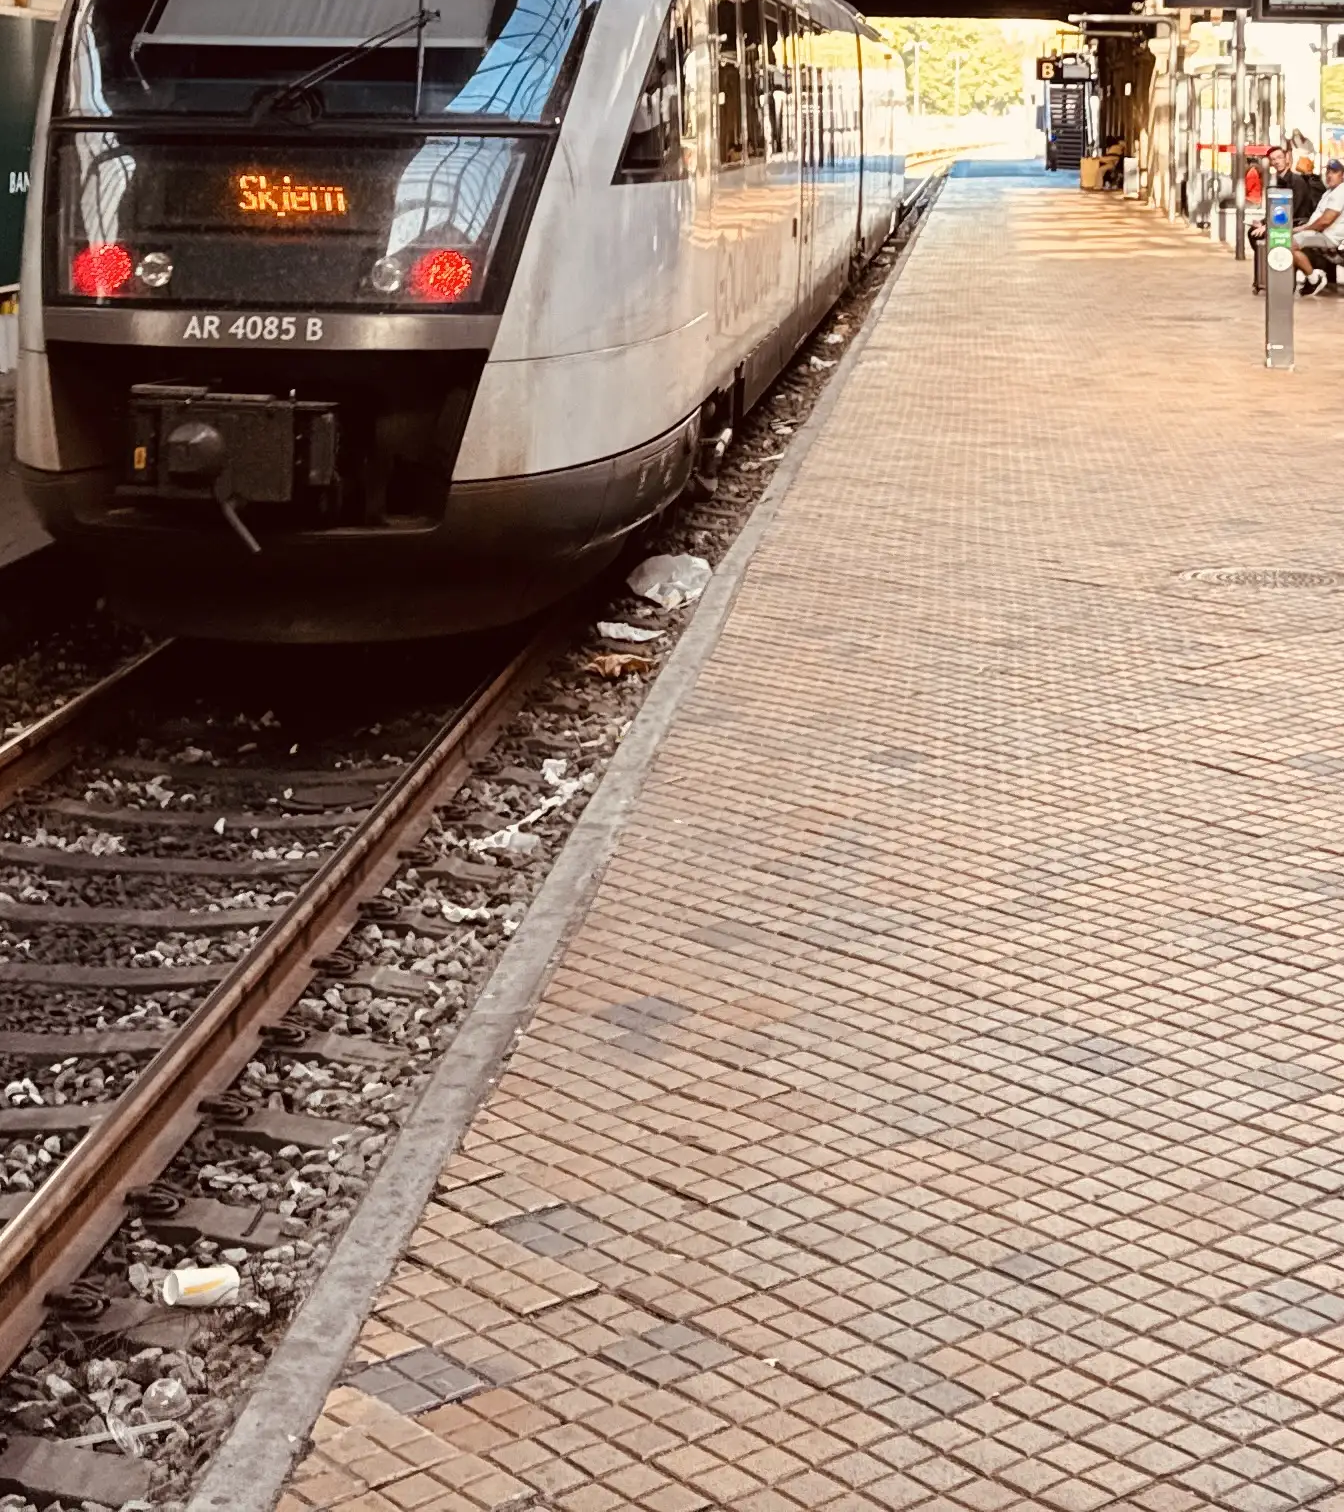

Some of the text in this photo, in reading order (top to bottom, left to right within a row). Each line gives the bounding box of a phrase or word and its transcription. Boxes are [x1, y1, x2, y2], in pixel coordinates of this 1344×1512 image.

[1041, 62, 1055, 79] B
[239, 175, 346, 217] Skjern
[182, 315, 323, 341] AR 4085 B
